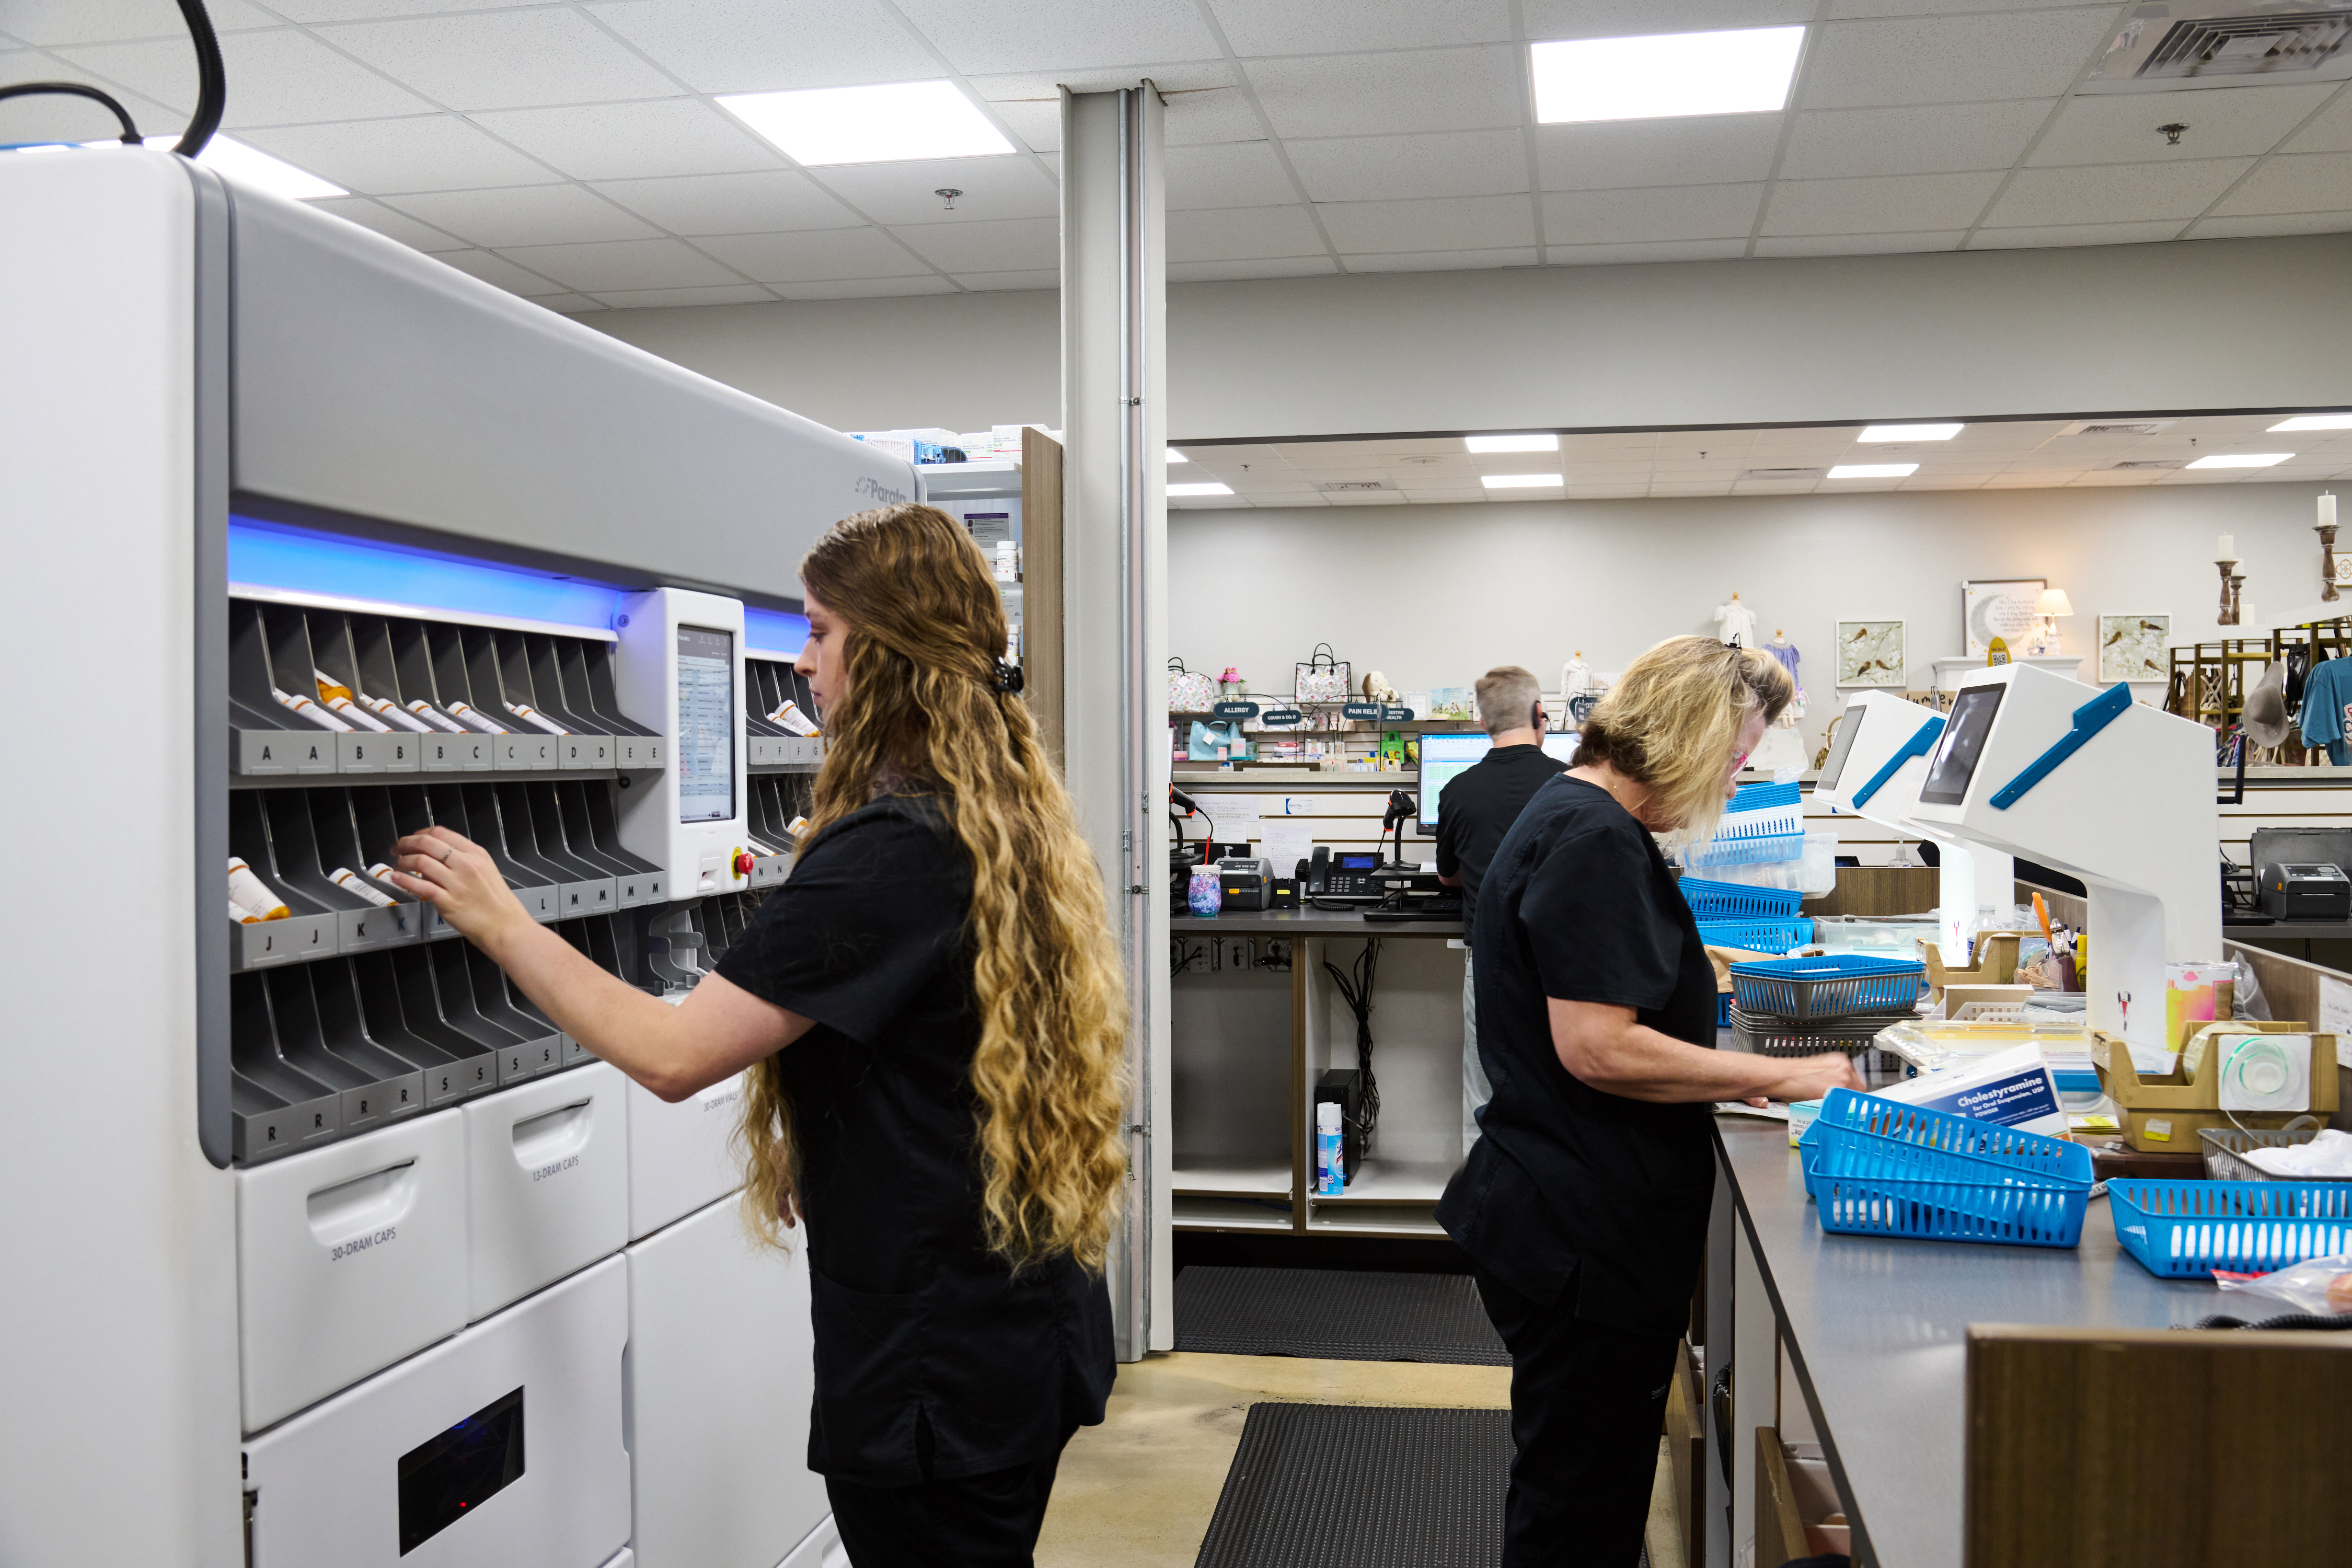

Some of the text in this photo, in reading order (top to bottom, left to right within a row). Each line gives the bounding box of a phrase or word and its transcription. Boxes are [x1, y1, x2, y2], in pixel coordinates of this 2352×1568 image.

[871, 479, 906, 505] Parata
[262, 745, 656, 760] A A B B B C C C D D E E
[759, 746, 818, 756] F F F G
[1383, 751, 1401, 760] ABC
[759, 865, 782, 877] N N
[266, 936, 272, 951] J
[312, 929, 318, 944] J
[357, 923, 365, 937] K
[398, 916, 406, 931] K
[541, 898, 546, 910] L
[571, 893, 579, 906] M
[599, 890, 606, 901] M
[628, 885, 634, 897] M
[652, 882, 659, 894] M
[268, 1126, 276, 1142] R
[315, 1113, 322, 1128] R
[361, 1100, 368, 1114] R
[401, 1089, 408, 1103] R
[442, 1077, 448, 1091] S
[477, 1067, 483, 1080] S
[513, 1057, 518, 1070] S
[544, 1049, 549, 1062] S
[704, 1091, 737, 1112] 30-DRAM VIALS
[1957, 1077, 2043, 1107] Cholestyramine
[1982, 1100, 1997, 1109] Oral
[1997, 1091, 2032, 1104] Suspension,
[2032, 1086, 2045, 1094] USP
[1975, 1107, 1999, 1118] POWDER
[533, 1155, 579, 1182] 13-DRAM CAPS
[332, 1227, 396, 1261] 30-DRAM CAPS
